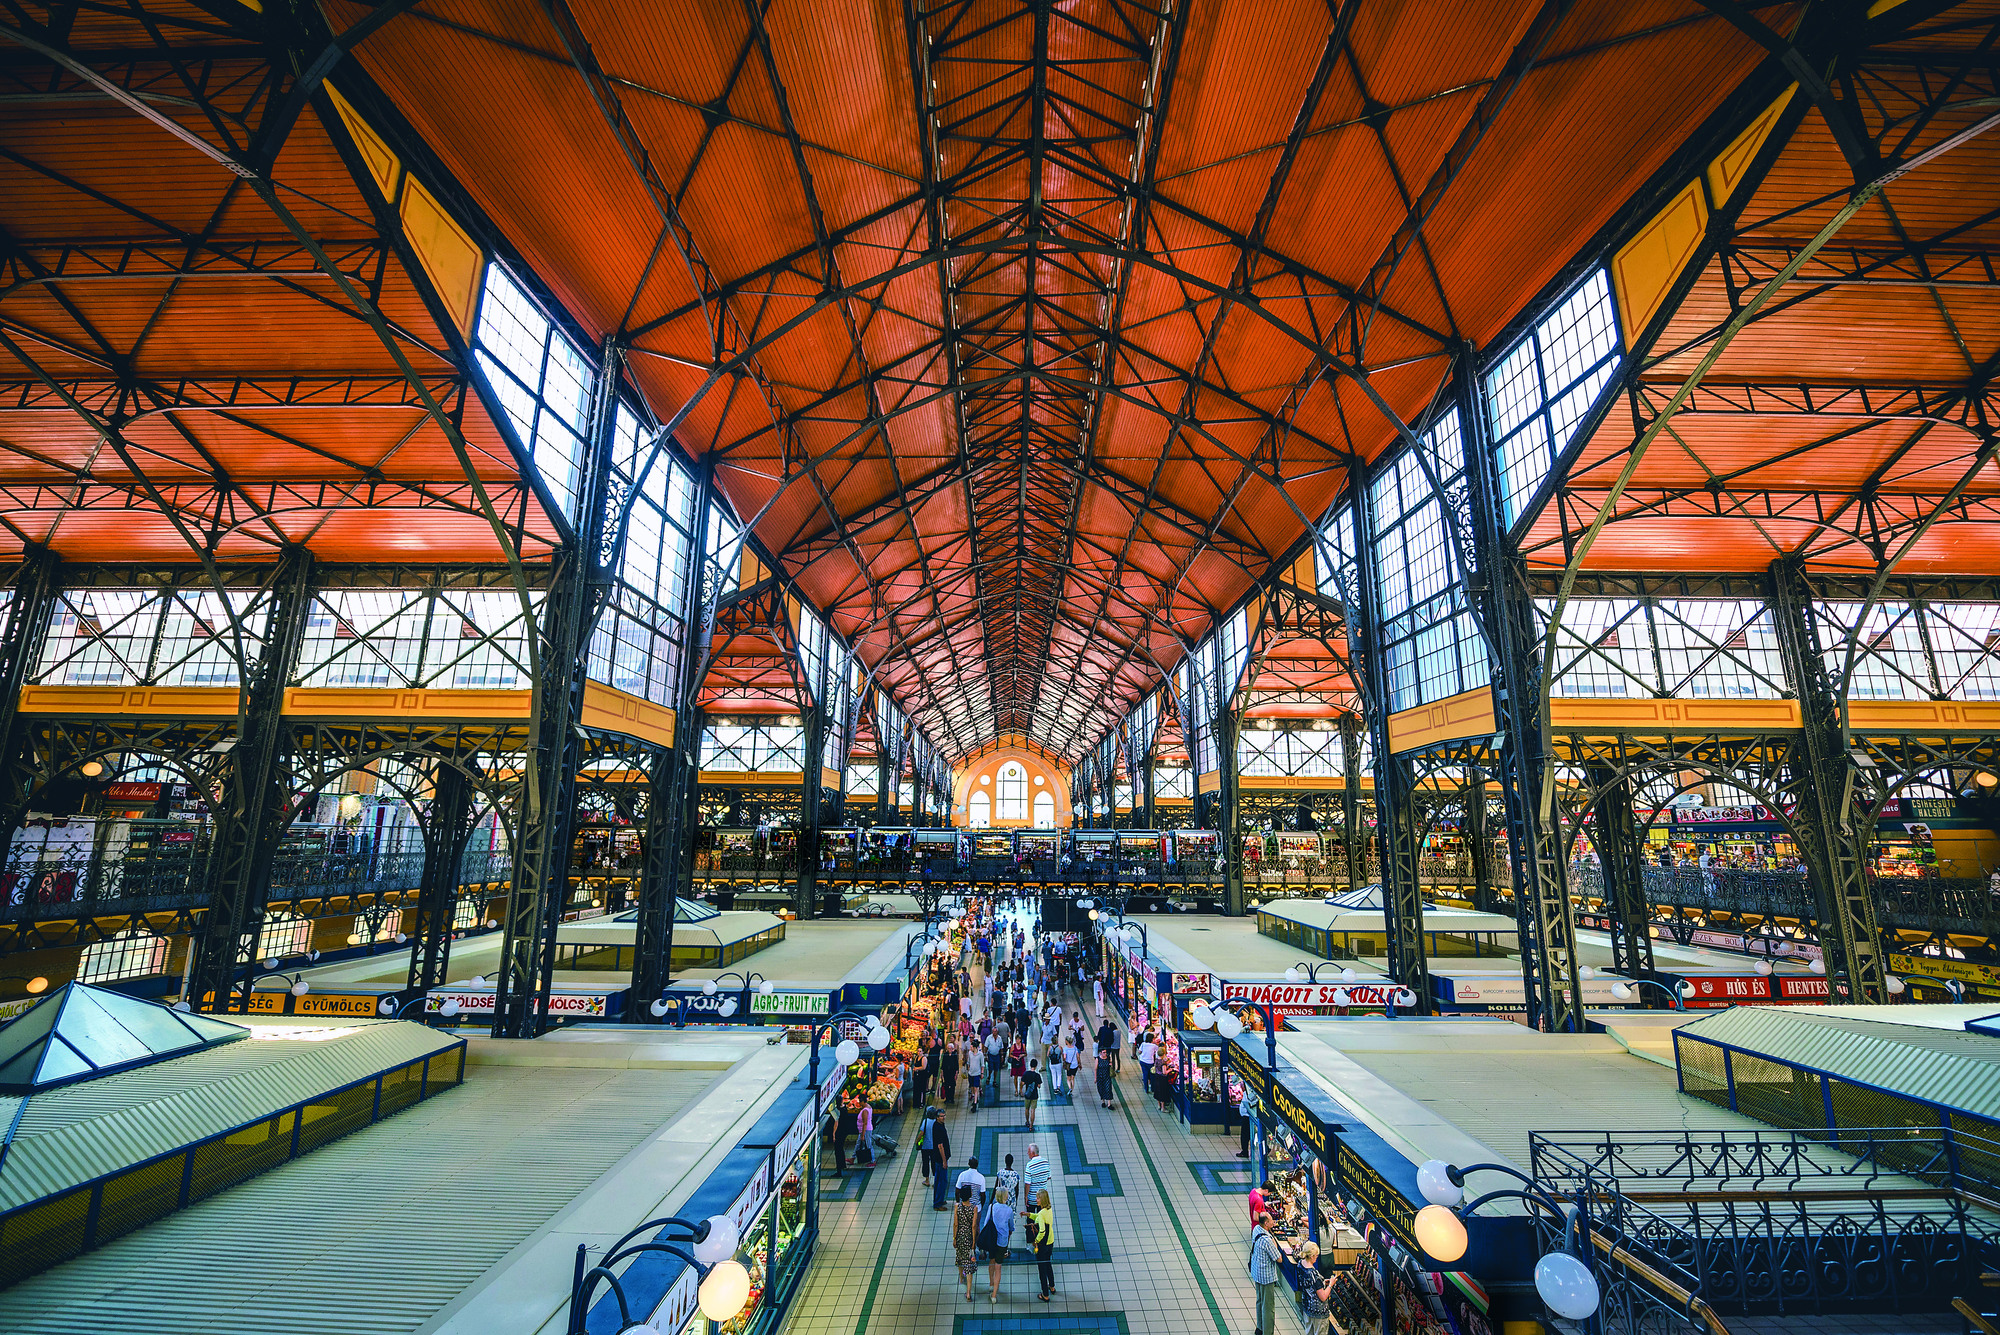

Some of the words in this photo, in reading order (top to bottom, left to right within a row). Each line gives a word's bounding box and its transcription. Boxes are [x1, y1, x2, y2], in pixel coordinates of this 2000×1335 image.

[1226, 985, 1313, 1004] FELVÁGOTT
[1726, 978, 1748, 995] HÚS
[1751, 978, 1766, 995] ÉS
[302, 998, 371, 1013] GYÜMÖLCS
[448, 995, 496, 1008] ÖLDSÉ
[753, 995, 810, 1012] AGRO-FRUIT
[1338, 1152, 1376, 1198] Chocolate
[1379, 1193, 1386, 1207] &
